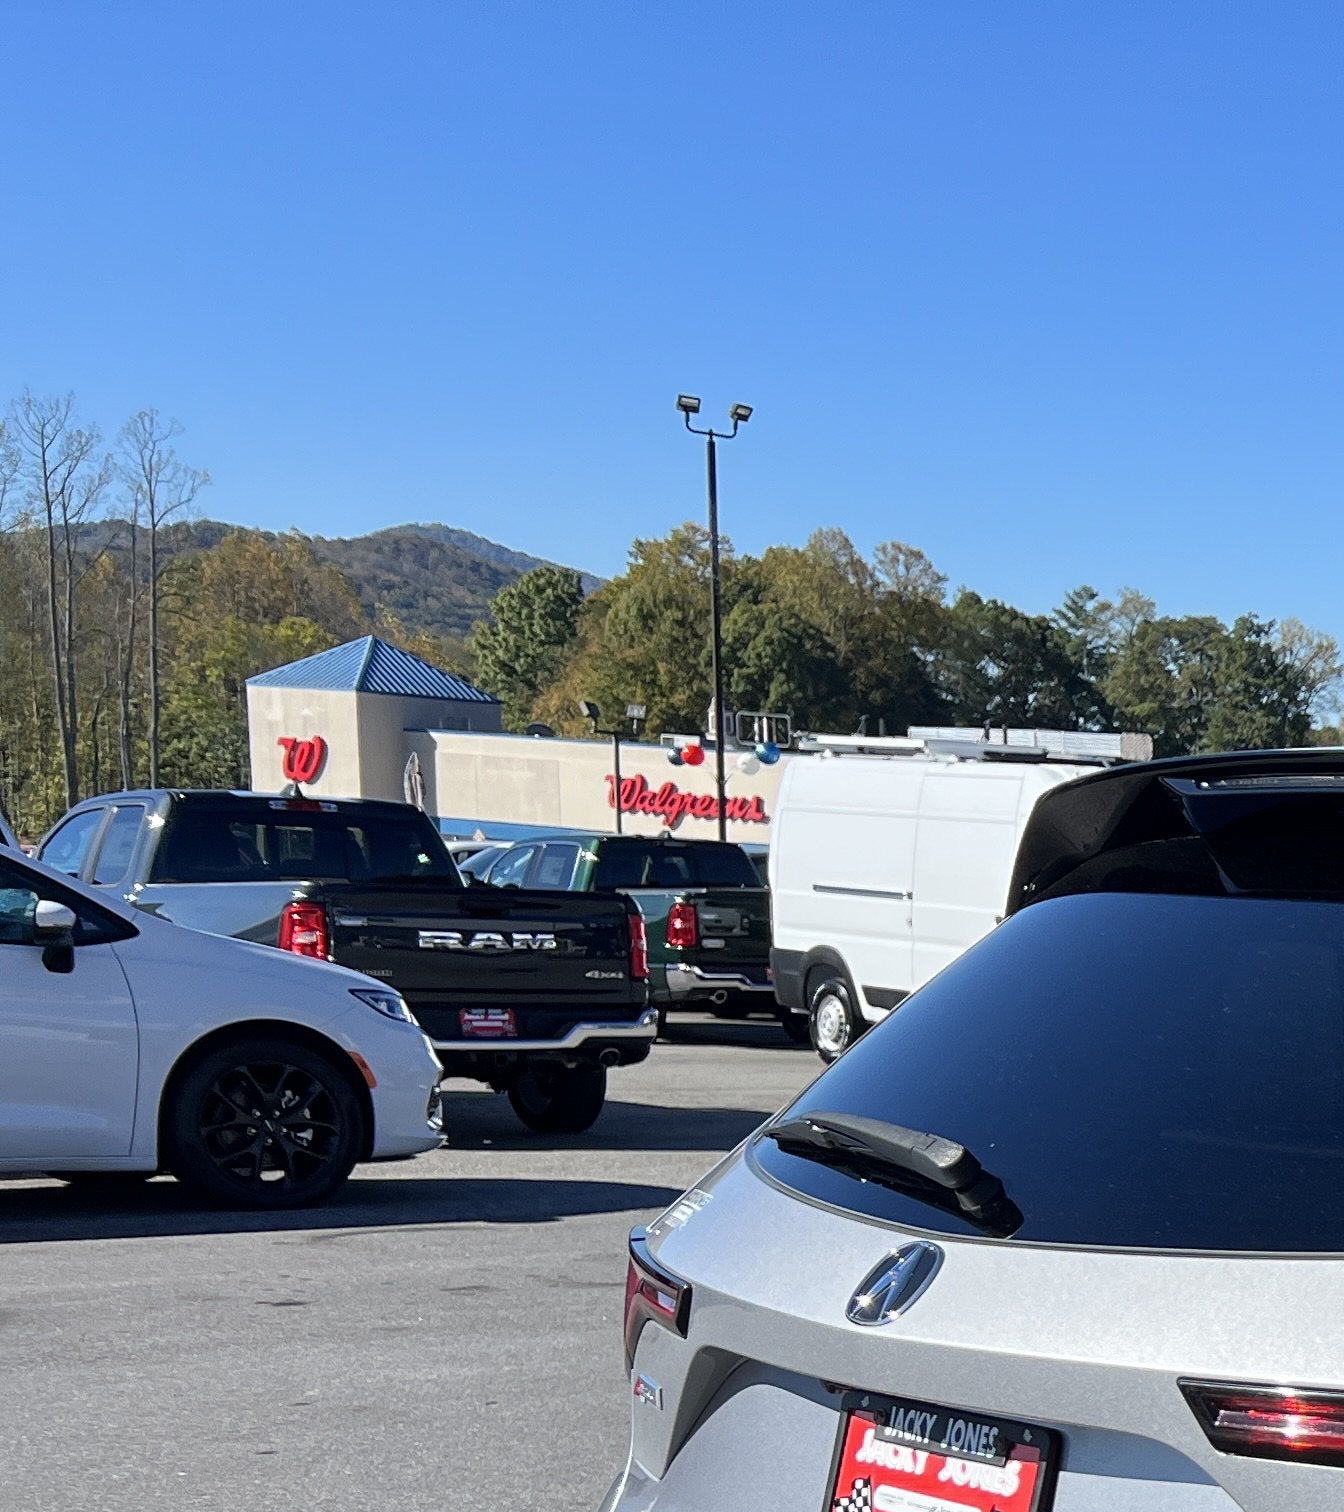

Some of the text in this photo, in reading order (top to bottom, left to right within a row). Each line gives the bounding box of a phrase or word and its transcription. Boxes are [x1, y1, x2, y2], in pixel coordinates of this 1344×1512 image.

[277, 735, 325, 782] W
[605, 774, 768, 827] Walgreens
[418, 930, 556, 950] RAM
[889, 1406, 999, 1454] JACKY JONES
